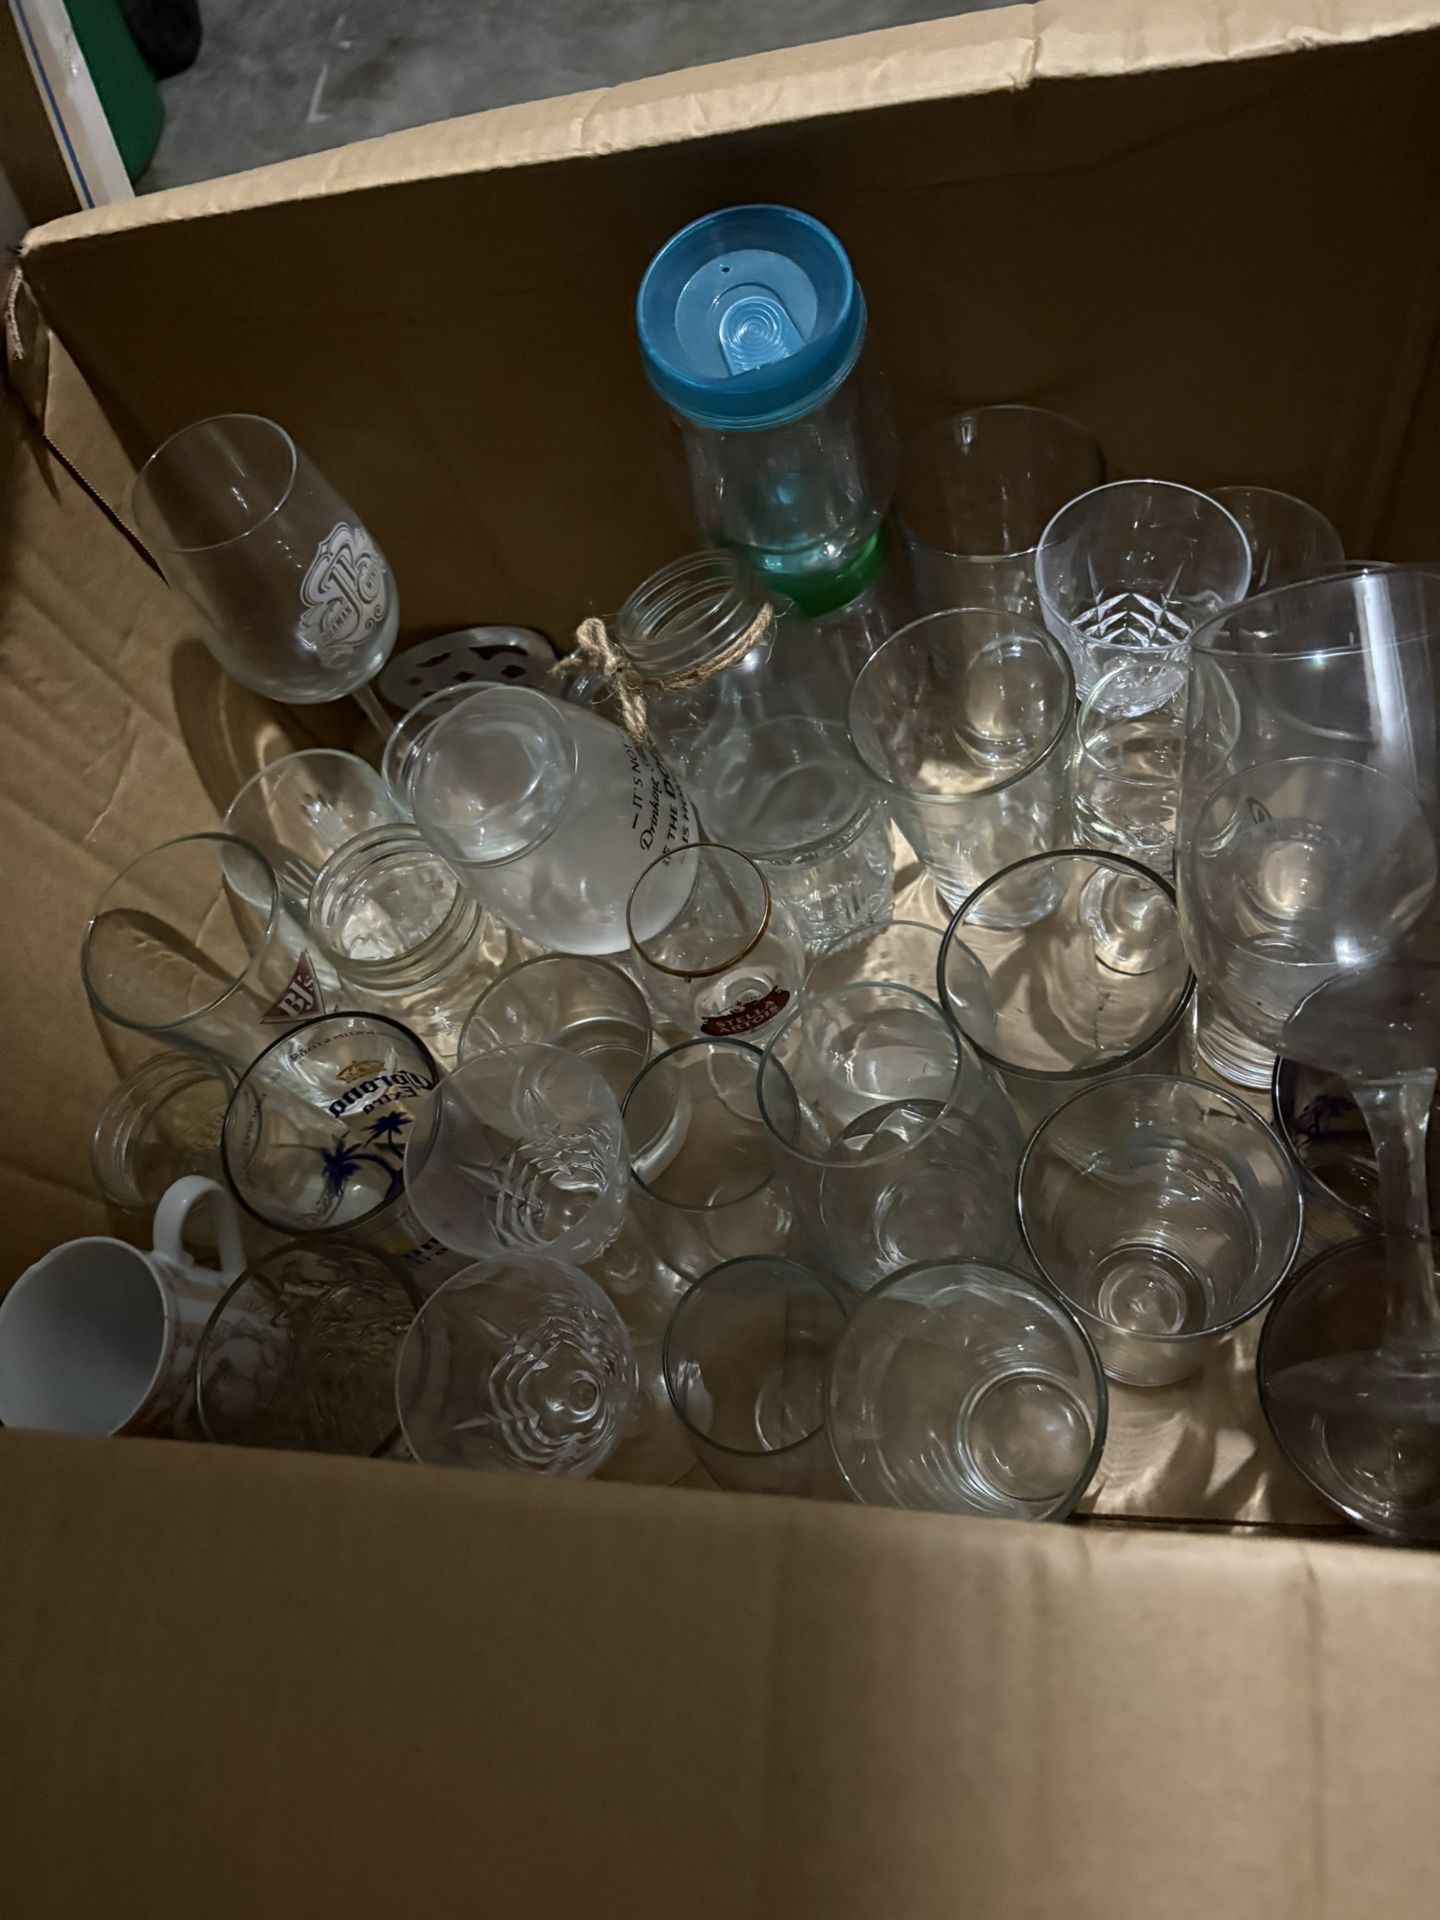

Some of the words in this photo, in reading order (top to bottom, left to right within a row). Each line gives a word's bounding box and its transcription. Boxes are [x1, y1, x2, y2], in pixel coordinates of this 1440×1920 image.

[632, 776, 644, 810] IT'S
[640, 776, 662, 851] Drinking
[666, 802, 678, 840] THE
[681, 825, 690, 844] IS
[715, 1000, 776, 1028] STELLA
[719, 1003, 779, 1034] ARTOIS
